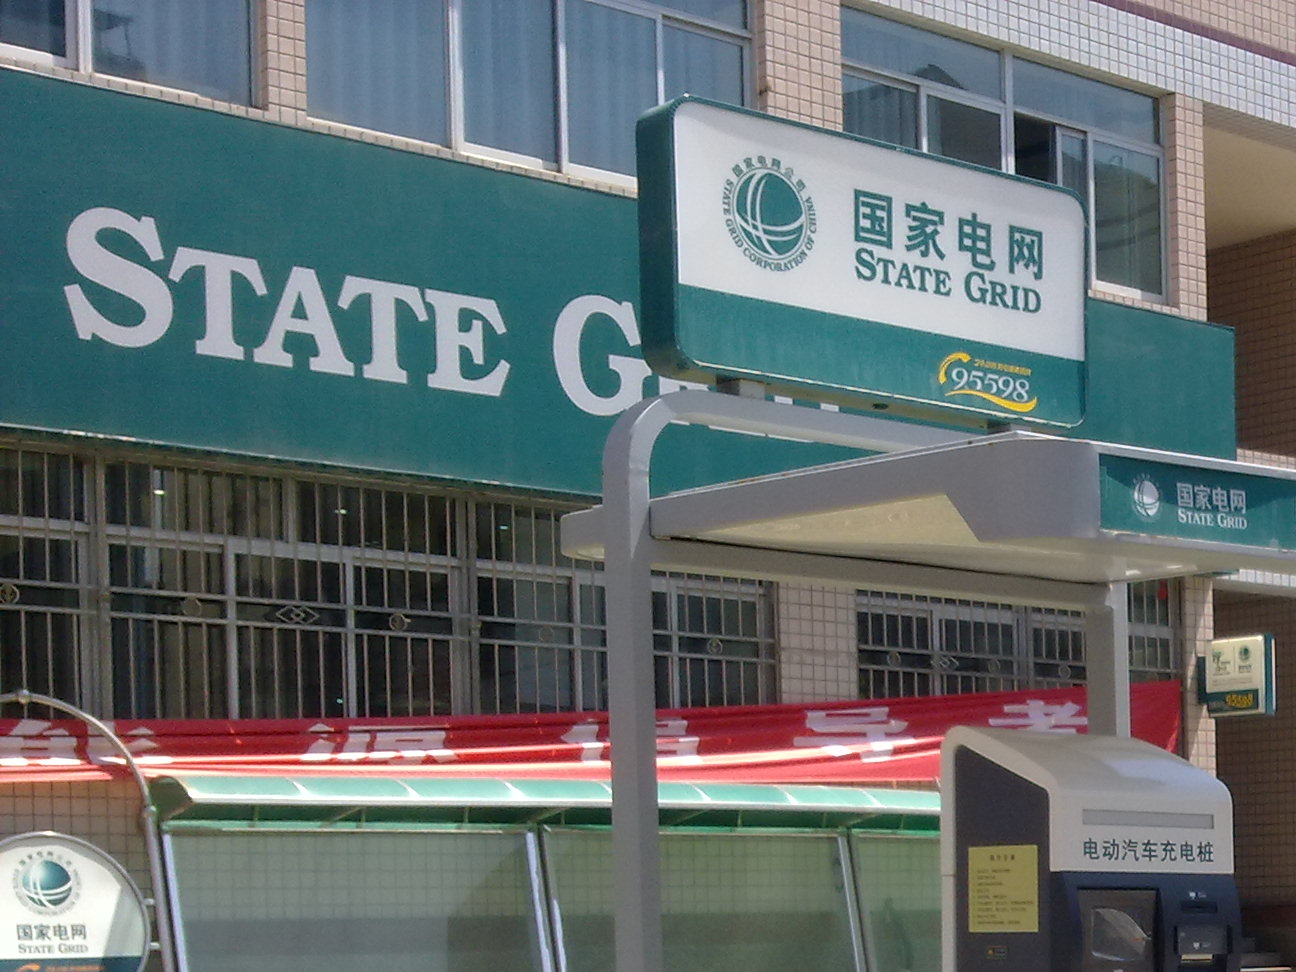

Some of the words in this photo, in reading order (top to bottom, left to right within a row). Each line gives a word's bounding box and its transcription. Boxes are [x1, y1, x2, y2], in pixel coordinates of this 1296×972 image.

[722, 178, 735, 216] STATE
[725, 218, 744, 248] GRID
[853, 188, 1044, 281] 国家电网
[743, 248, 808, 272] CORPORATION
[854, 247, 952, 297] STATE
[964, 271, 1042, 314] GRID
[64, 206, 511, 396] STATE
[951, 367, 1030, 402] 95598
[1176, 482, 1247, 514] 国家电网
[1178, 508, 1214, 526] STATE
[1217, 512, 1248, 530] GRID
[1083, 838, 1215, 863] 电动汽车充电桩
[16, 924, 87, 941] 国家电网
[18, 943, 55, 954] STATE
[58, 943, 89, 954] GRID
